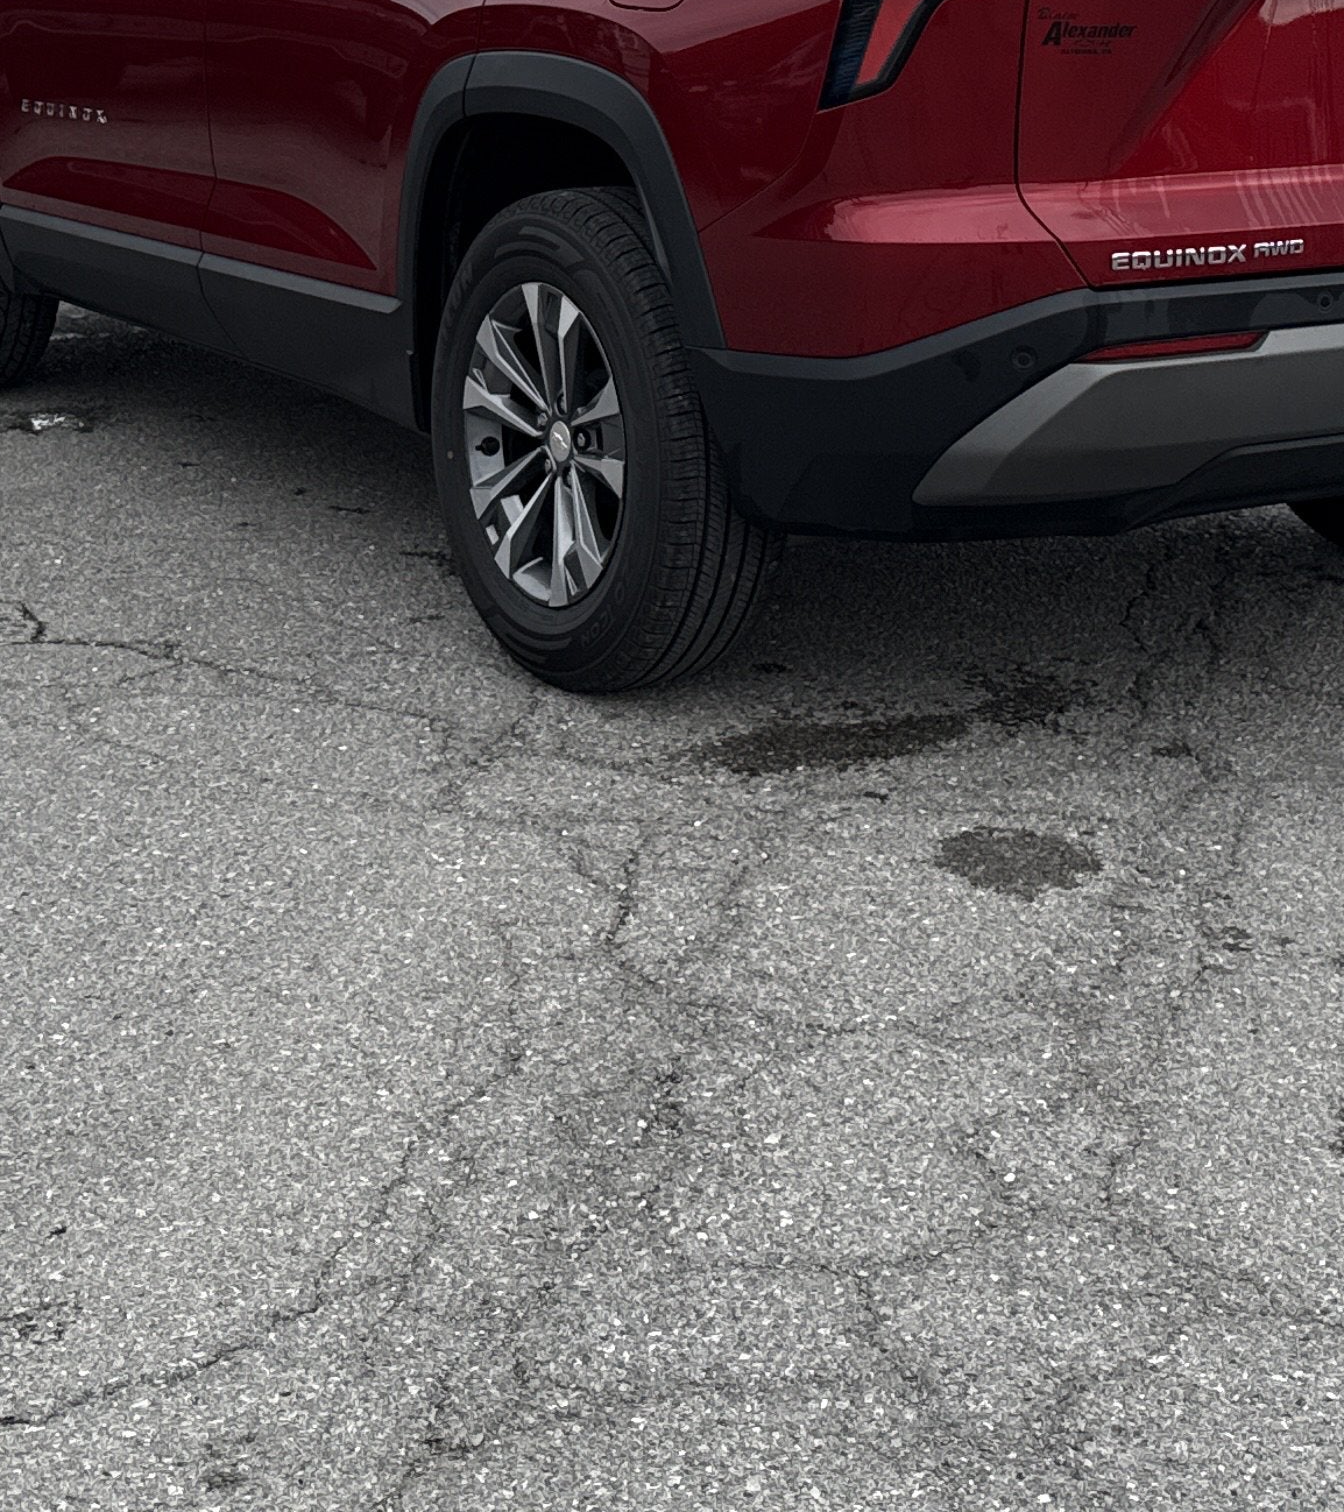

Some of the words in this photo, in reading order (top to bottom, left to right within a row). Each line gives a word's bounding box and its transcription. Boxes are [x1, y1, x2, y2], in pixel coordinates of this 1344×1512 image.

[1041, 20, 1138, 46] Alexander
[21, 98, 108, 124] EQUINOX
[1111, 244, 1247, 270] EQUINOX
[1254, 239, 1304, 258] AWD
